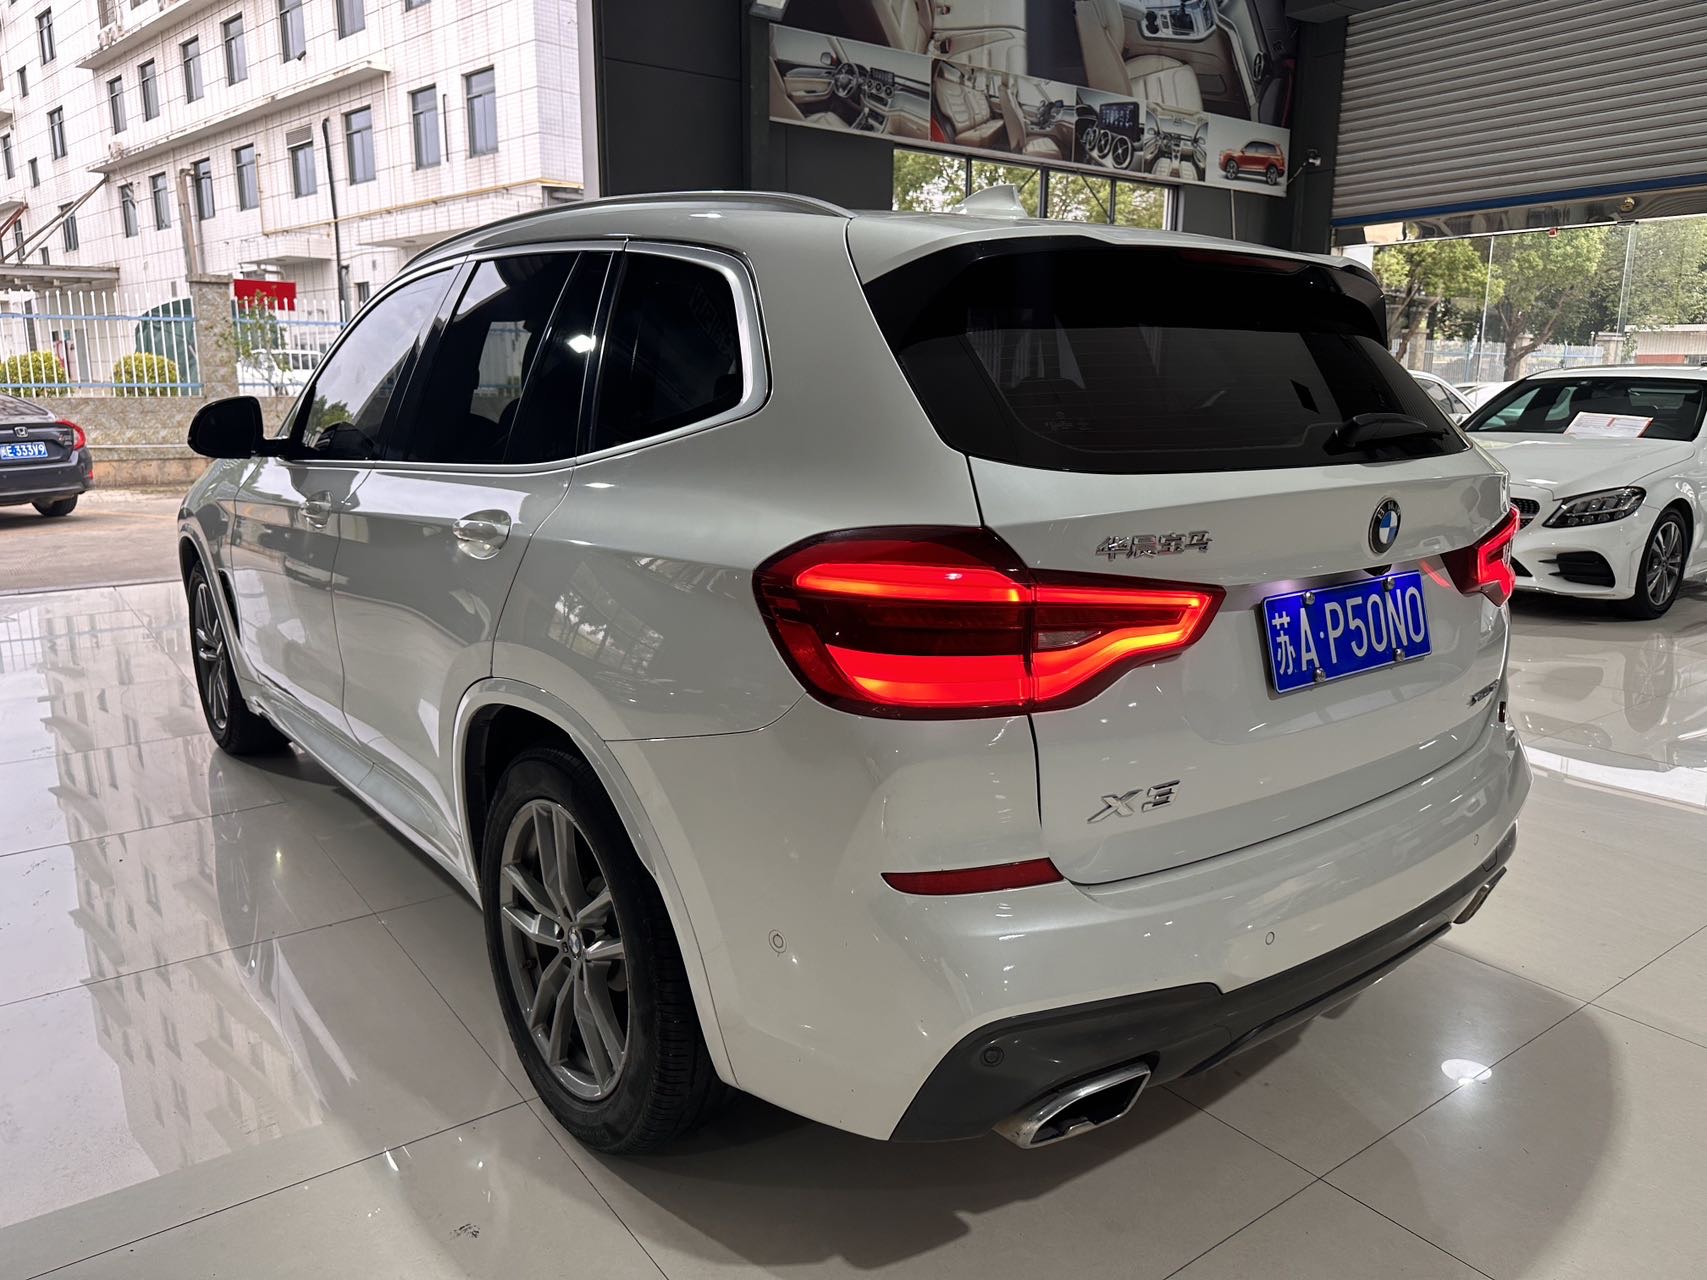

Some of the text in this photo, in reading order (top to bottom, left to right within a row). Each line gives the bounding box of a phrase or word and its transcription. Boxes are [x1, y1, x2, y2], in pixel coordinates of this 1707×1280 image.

[1096, 531, 1212, 561] 华晨宝马
[1087, 780, 1180, 824] X3
